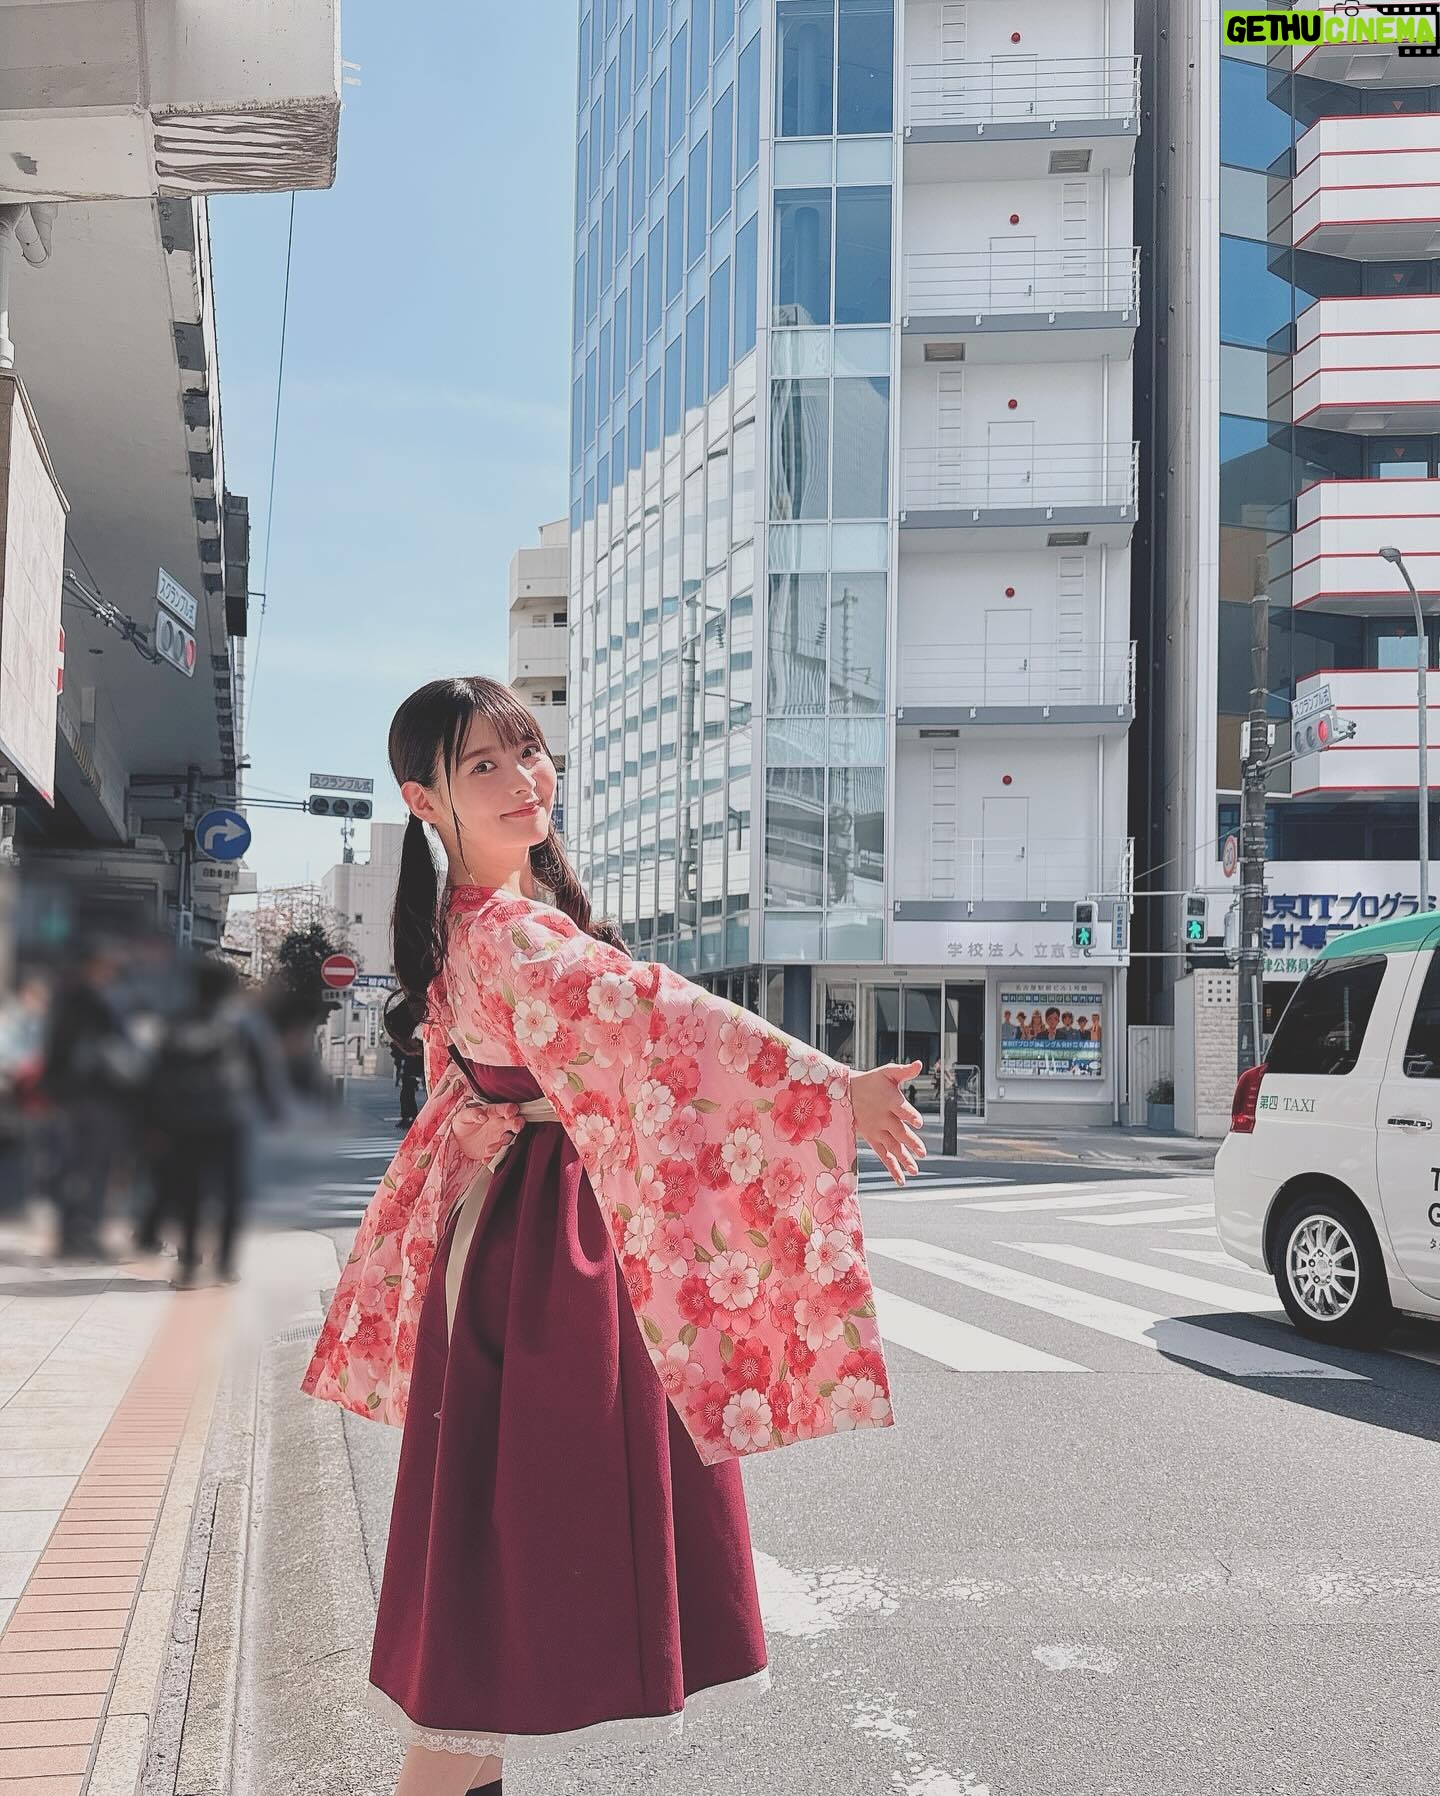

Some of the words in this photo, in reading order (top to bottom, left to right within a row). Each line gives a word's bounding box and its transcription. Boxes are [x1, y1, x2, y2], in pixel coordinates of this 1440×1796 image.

[1294, 689, 1331, 717] スクランブル式
[313, 775, 371, 791] スクランブル式
[947, 942, 1024, 958] 学校法人
[1259, 1095, 1279, 1110] 第四
[1283, 1097, 1317, 1112] TAXI
